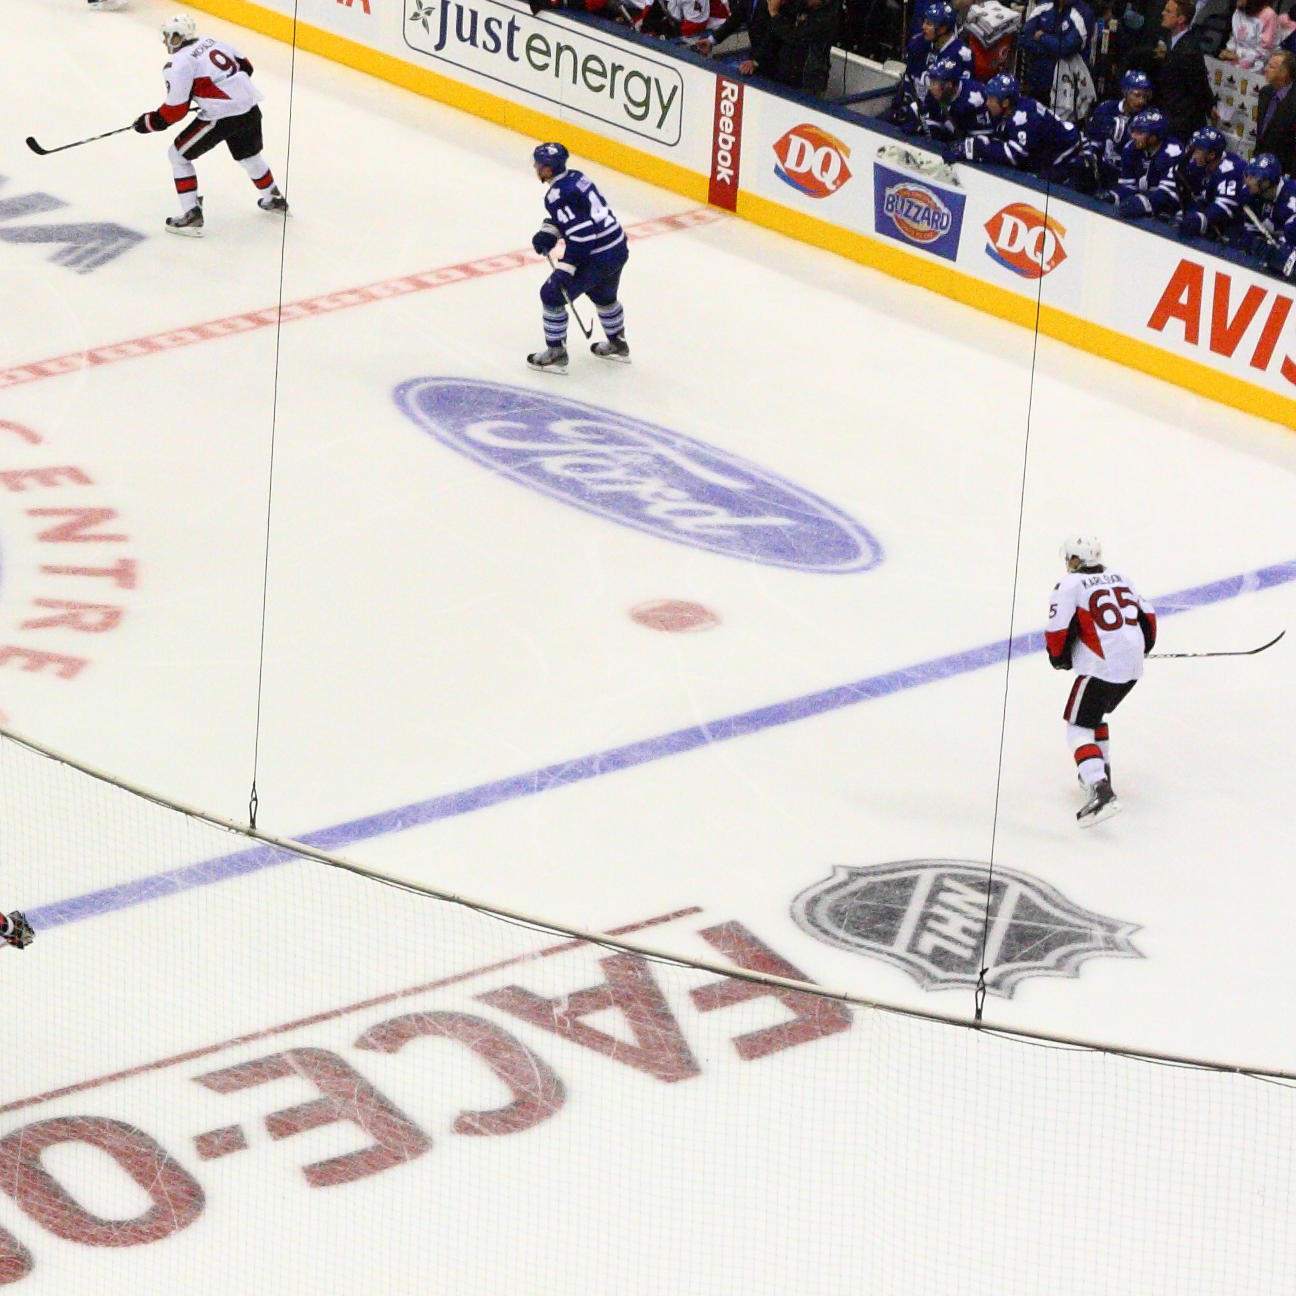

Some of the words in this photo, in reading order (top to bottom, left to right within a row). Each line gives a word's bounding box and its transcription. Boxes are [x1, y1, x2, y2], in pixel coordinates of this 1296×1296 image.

[209, 49, 238, 79] 9
[715, 78, 739, 184] Reebok
[787, 133, 844, 191] DQ
[1216, 180, 1237, 197] 42
[996, 213, 1056, 272] DQ
[463, 417, 800, 533] Ford
[1088, 586, 1141, 632] 65
[917, 878, 985, 960] NHL
